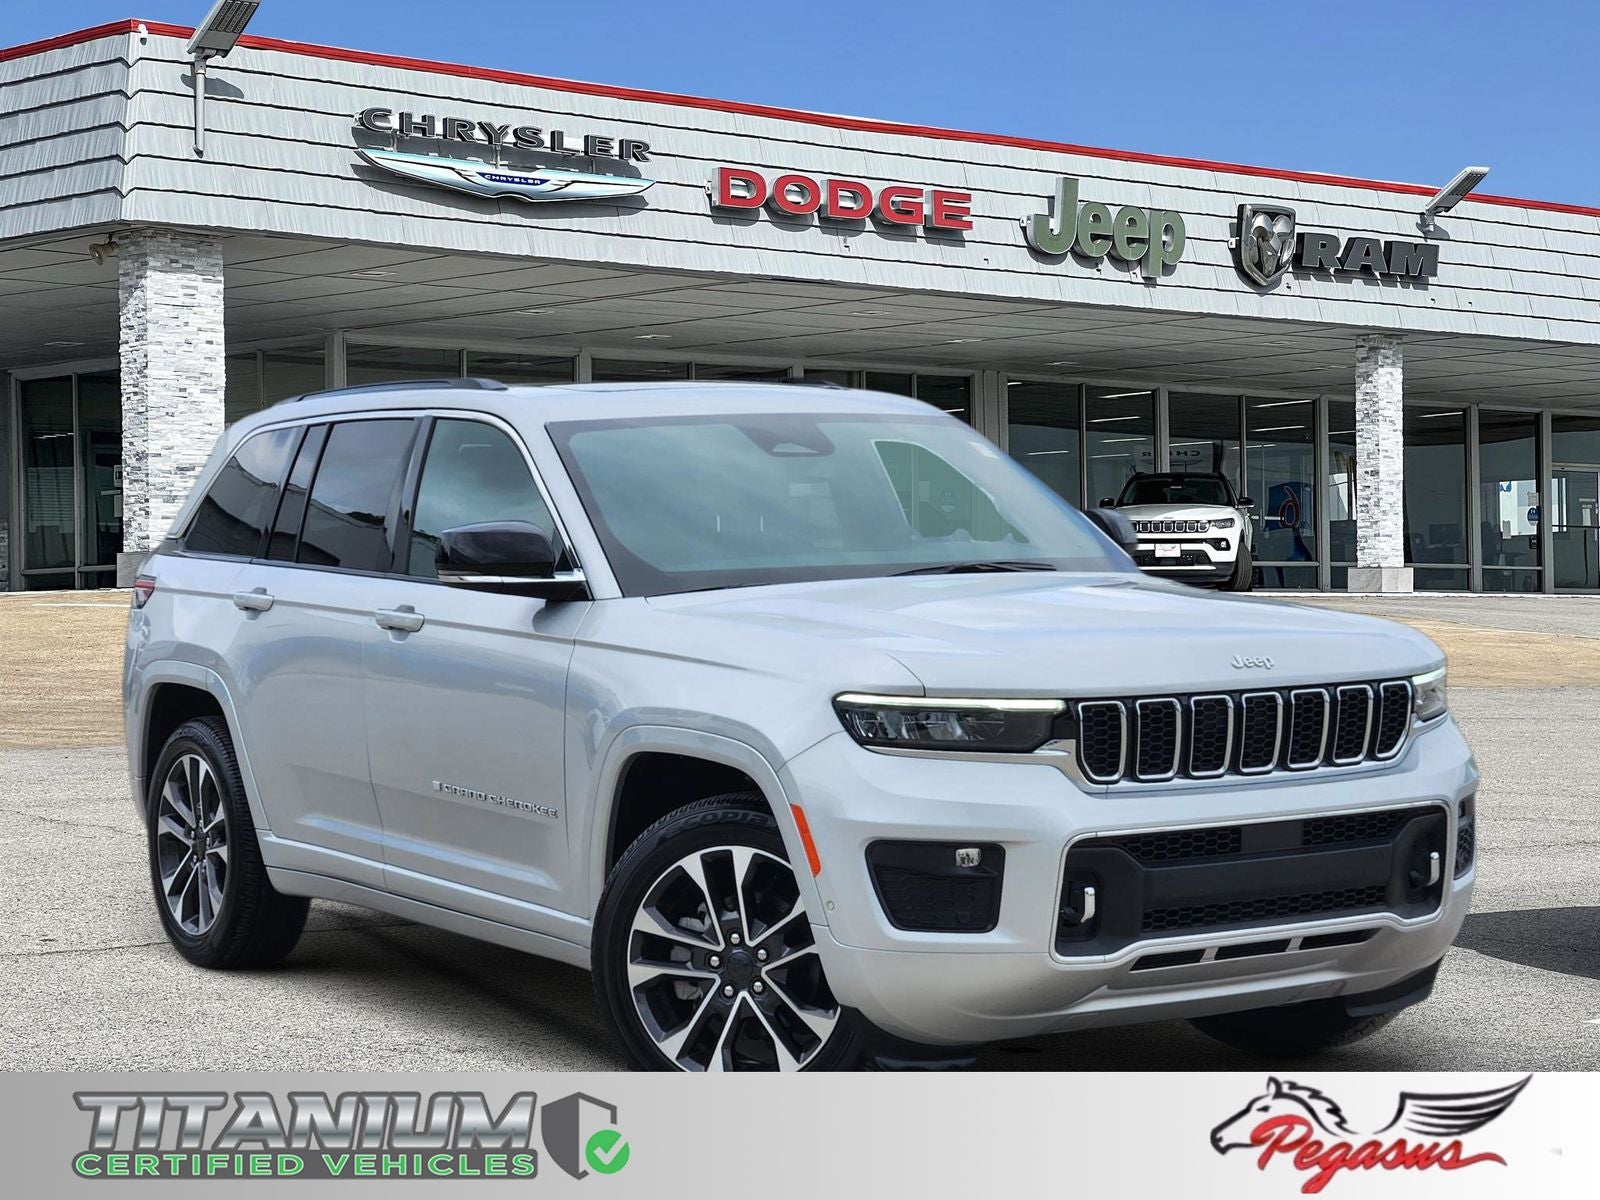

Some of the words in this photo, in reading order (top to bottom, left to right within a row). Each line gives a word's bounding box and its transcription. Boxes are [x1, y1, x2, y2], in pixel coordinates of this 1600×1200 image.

[357, 106, 651, 162] CHRYSLER
[484, 174, 541, 185] CHRYSLER
[712, 167, 973, 230] DODGE
[1028, 177, 1186, 278] Jeep
[1298, 232, 1440, 277] RAM
[1230, 654, 1274, 670] Jeep
[443, 783, 486, 801] GRAND
[488, 794, 558, 818] CHEROKEE
